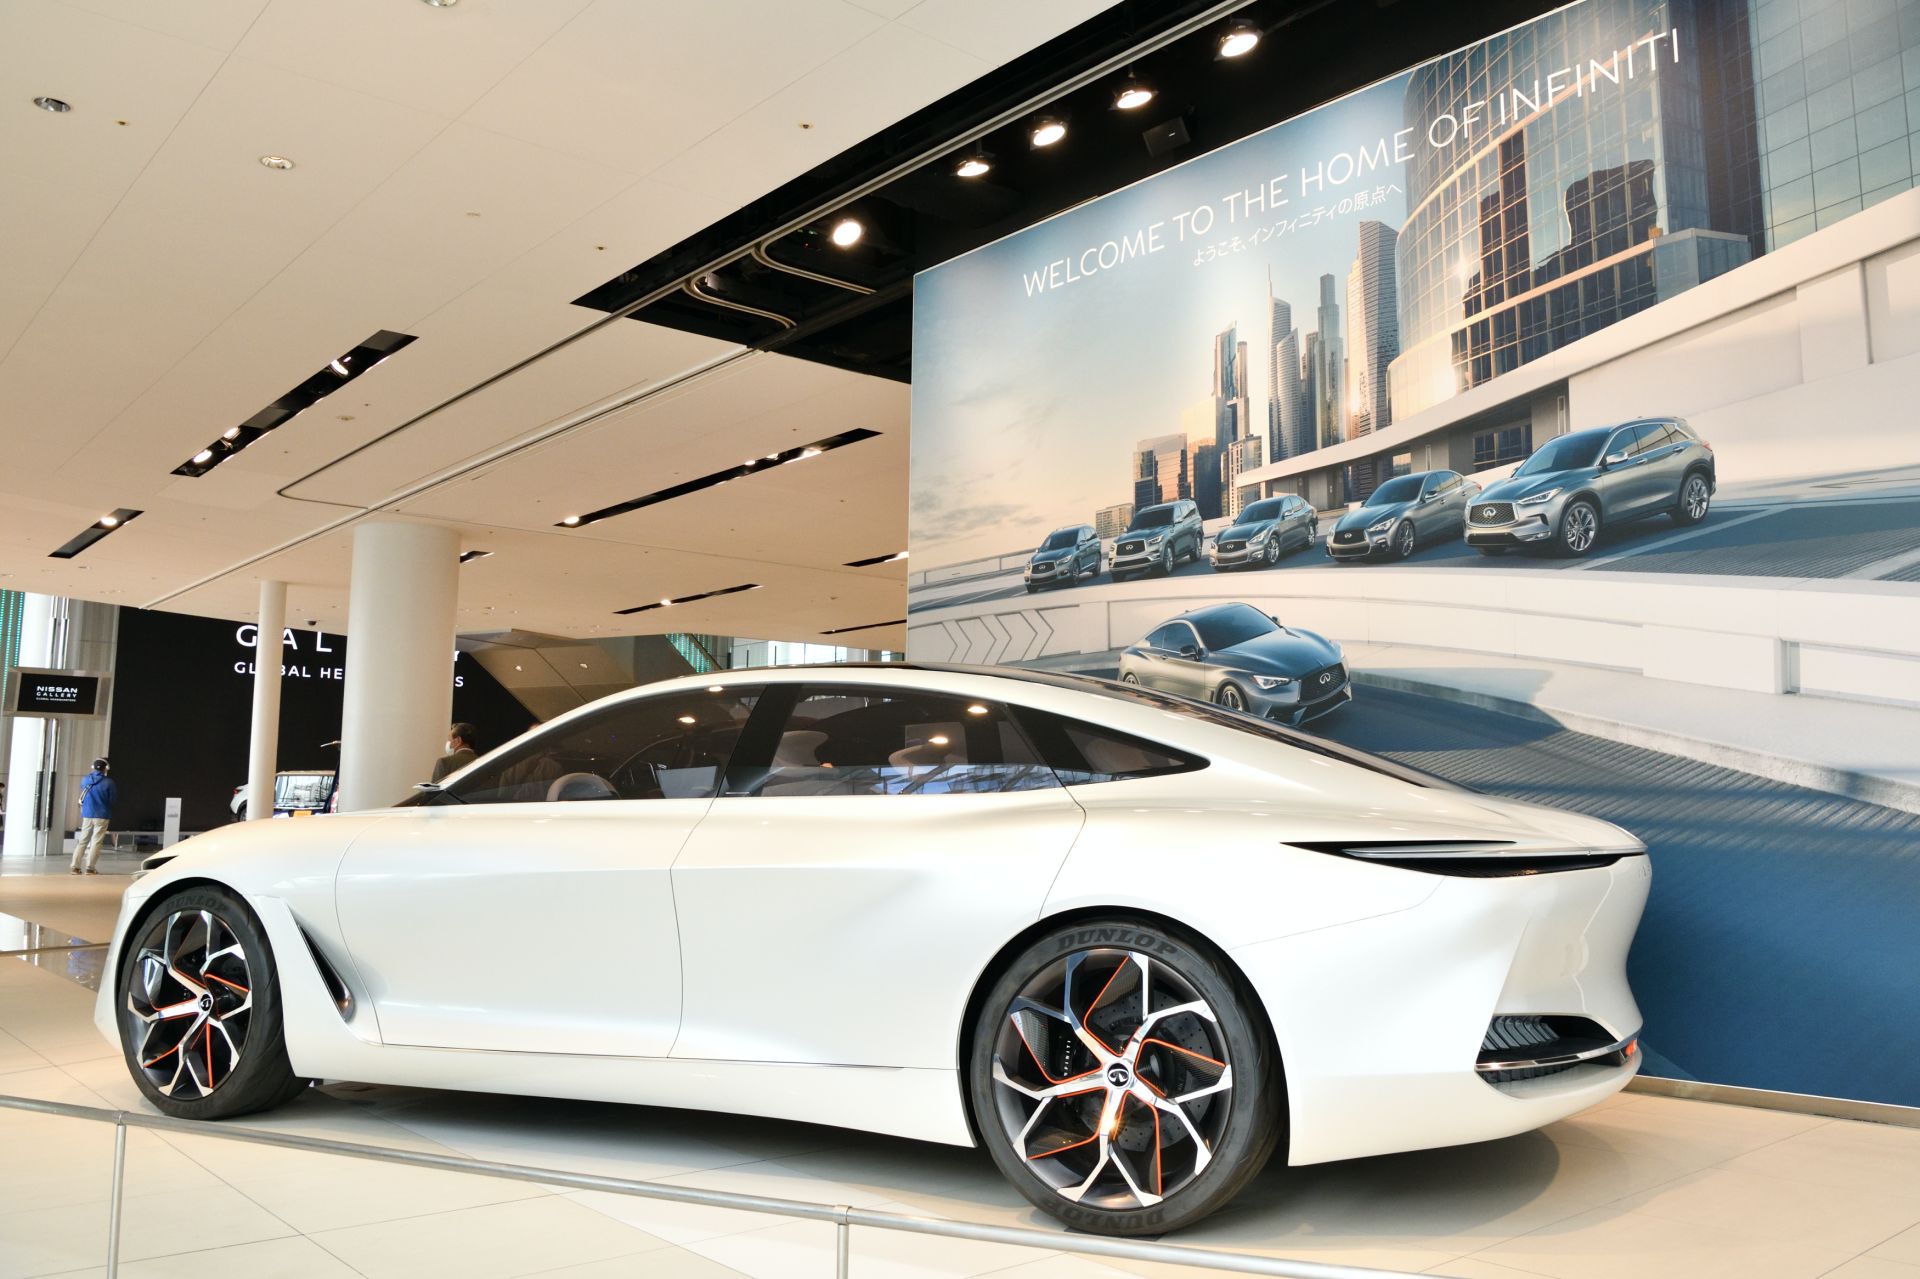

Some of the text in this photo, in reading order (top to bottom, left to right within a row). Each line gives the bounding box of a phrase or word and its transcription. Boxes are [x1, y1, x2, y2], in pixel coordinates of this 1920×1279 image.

[1022, 28, 1679, 297] WELCOME TO THE HOME OF INFINITI
[1192, 184, 1403, 267] ようこそ、インフィニティの原点へ
[234, 661, 312, 678] GLAL
[36, 685, 78, 693] NISSAN
[1057, 928, 1179, 955] DUNLOP
